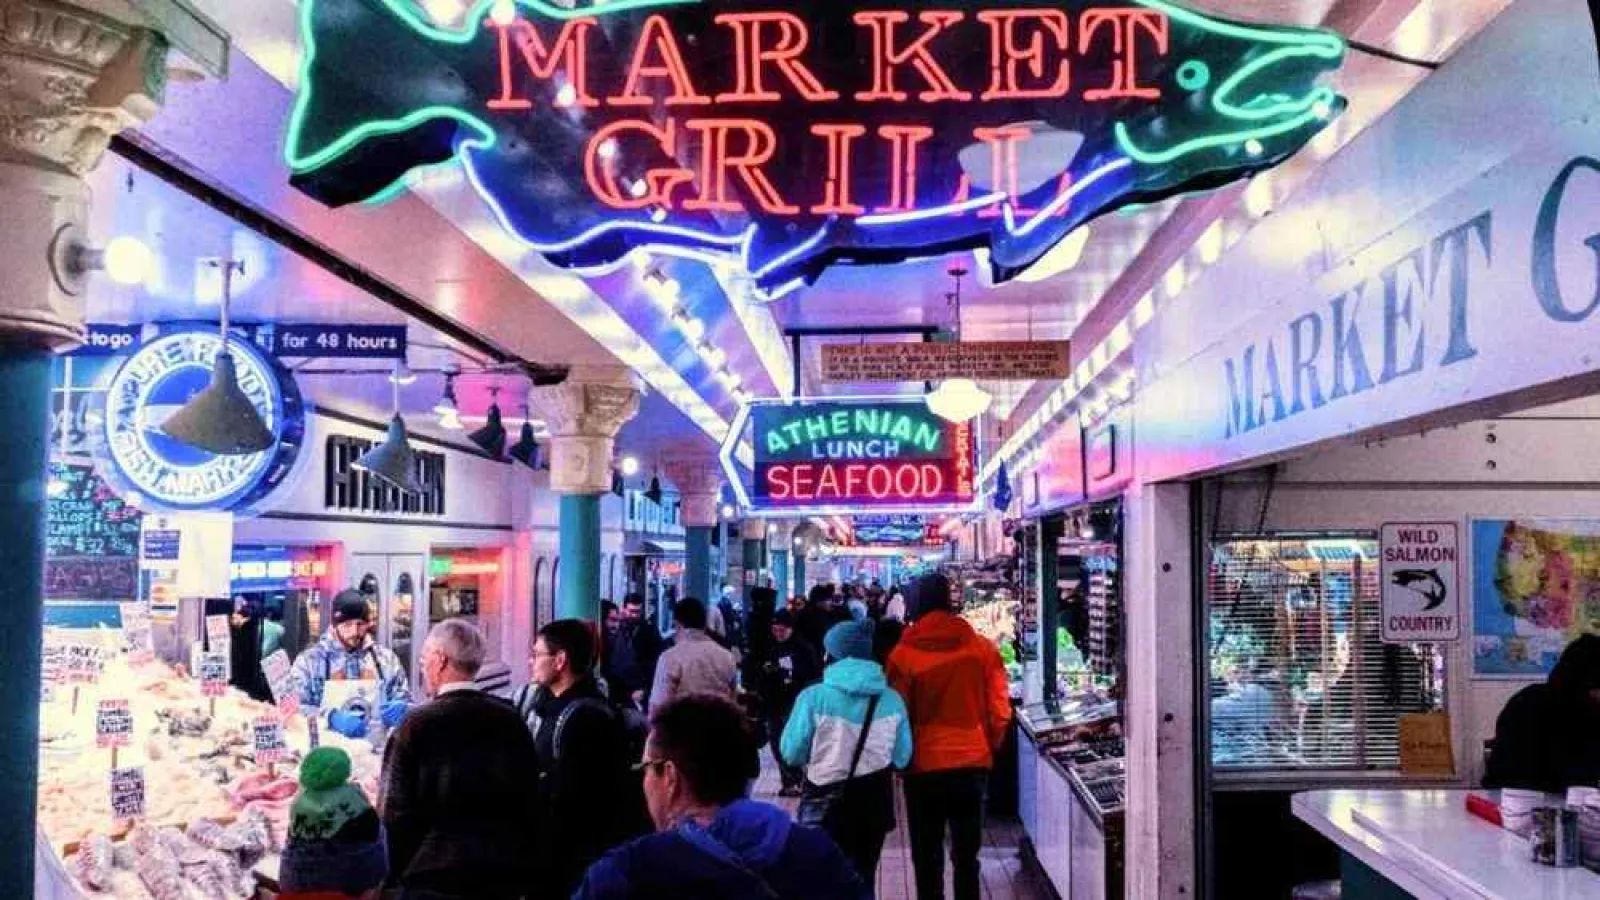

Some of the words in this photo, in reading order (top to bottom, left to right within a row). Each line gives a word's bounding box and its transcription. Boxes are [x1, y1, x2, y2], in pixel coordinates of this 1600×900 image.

[486, 10, 1169, 108] MARKET
[584, 118, 1071, 217] GRILL
[1224, 210, 1492, 440] MARKET
[283, 331, 309, 347] for
[316, 333, 339, 347] 48
[347, 332, 397, 348] hours
[766, 408, 941, 454] ATHENIAN
[812, 440, 900, 460] LUNCH
[767, 464, 943, 499] SEAFOOD
[1396, 530, 1439, 544] WILD
[1385, 547, 1455, 562] SALMON
[1389, 616, 1454, 631] COUNTRY
